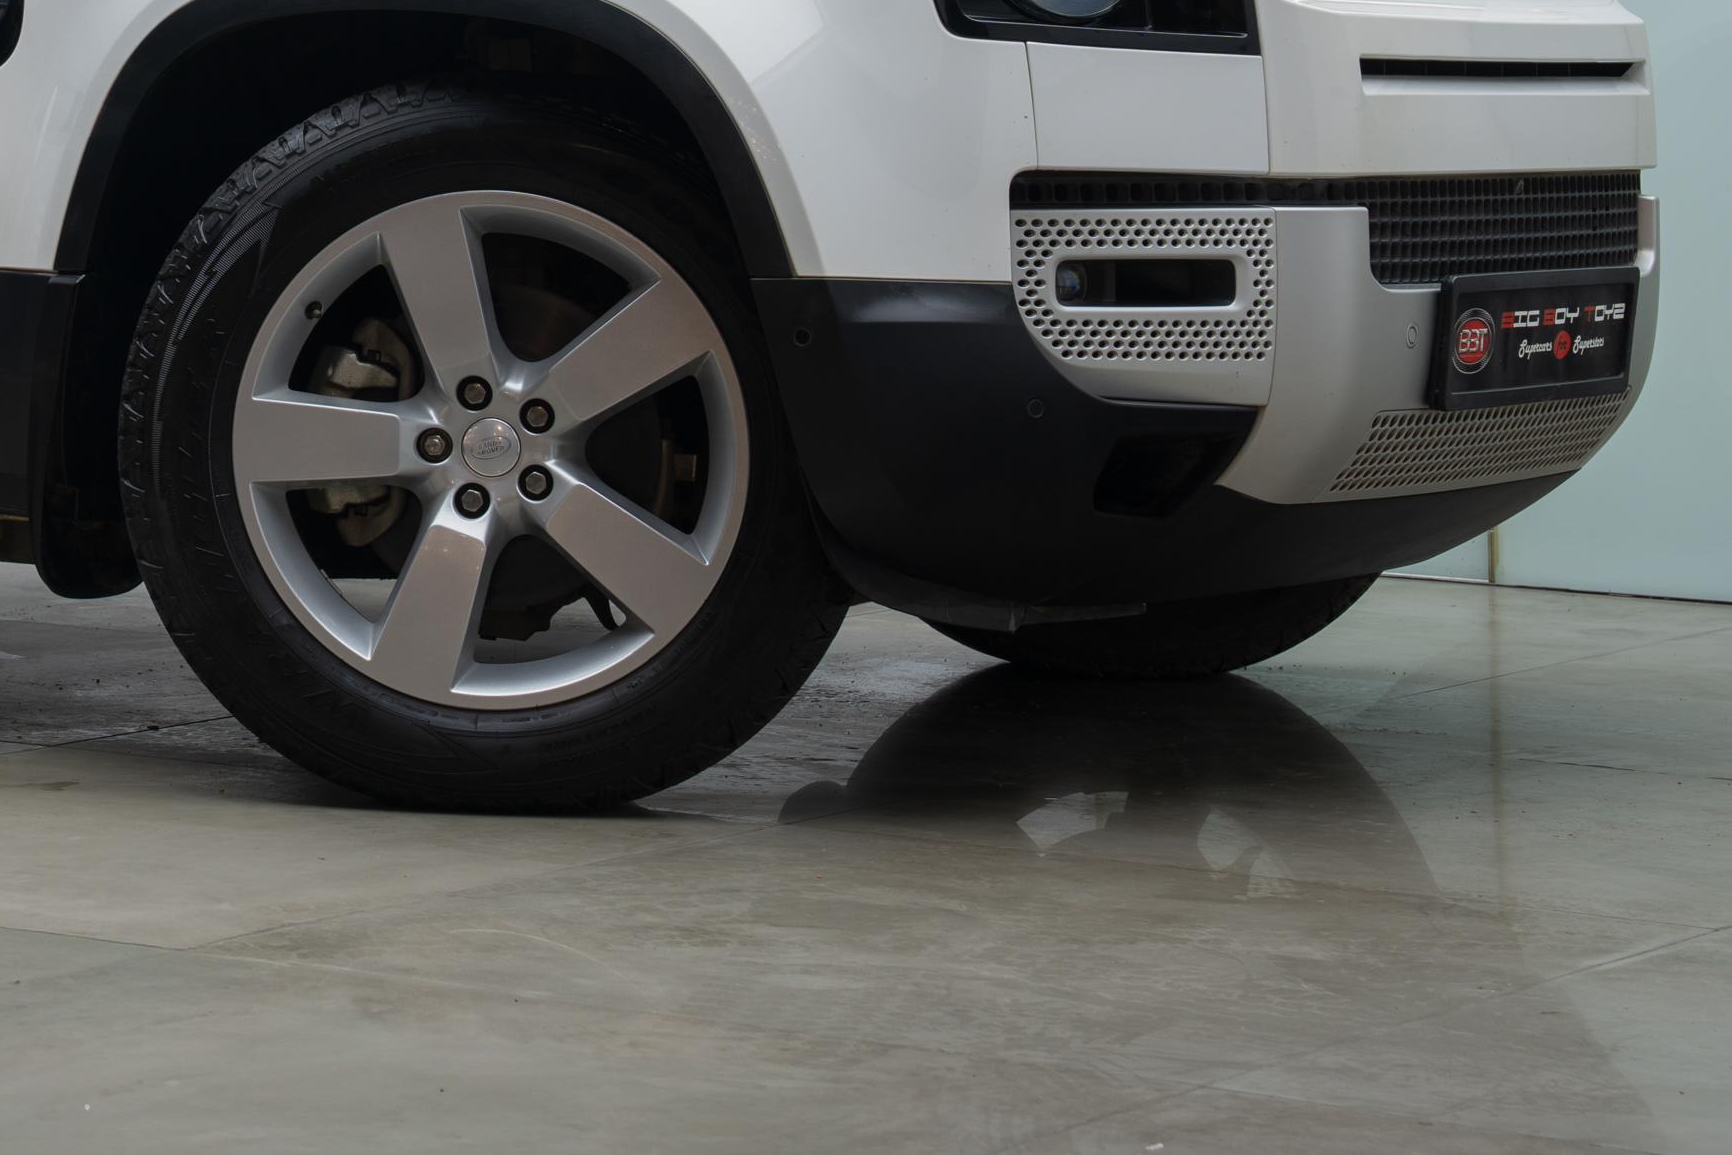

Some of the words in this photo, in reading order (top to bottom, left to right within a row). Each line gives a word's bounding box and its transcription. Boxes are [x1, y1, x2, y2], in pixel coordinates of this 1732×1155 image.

[1501, 310, 1540, 328] BIG
[1543, 307, 1580, 325] BOY
[1518, 339, 1553, 360] Supercars
[1556, 336, 1568, 358] for
[1572, 335, 1605, 356] Superstars
[479, 441, 498, 450] LAND
[481, 446, 505, 455] ROVER
[178, 316, 376, 735] WRANGLER
